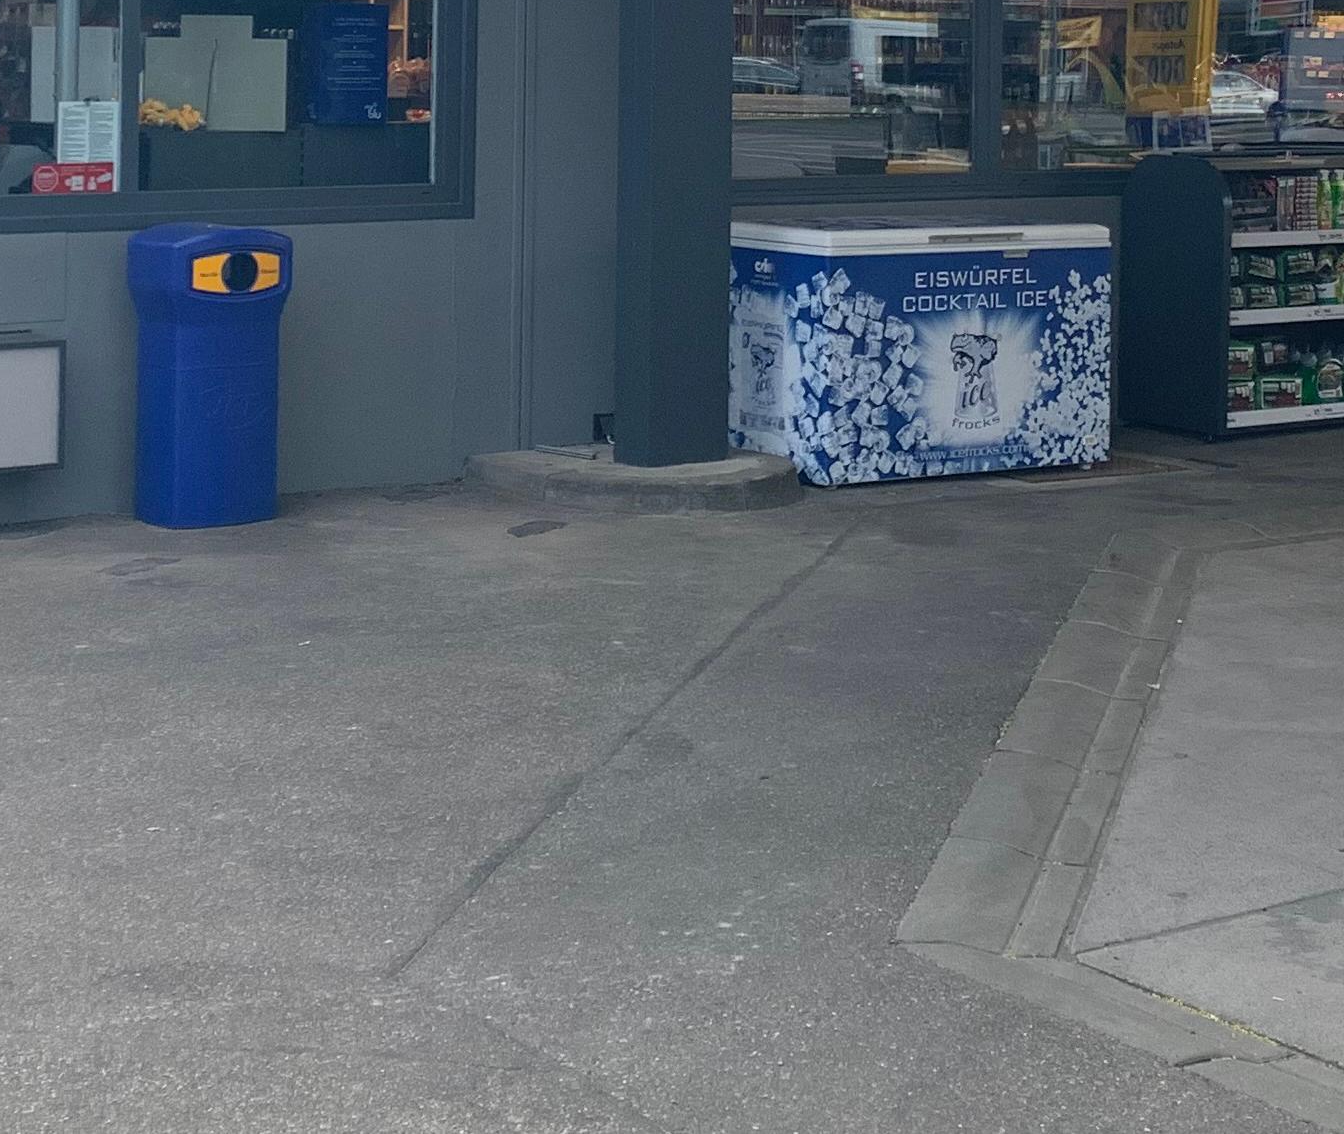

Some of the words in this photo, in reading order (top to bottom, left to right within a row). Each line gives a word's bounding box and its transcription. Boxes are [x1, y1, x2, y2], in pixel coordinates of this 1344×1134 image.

[914, 265, 1038, 289] EISWÜRFEL
[902, 293, 1007, 313] COCKTAIL
[1016, 290, 1048, 308] ICE
[951, 417, 1001, 431] frocks
